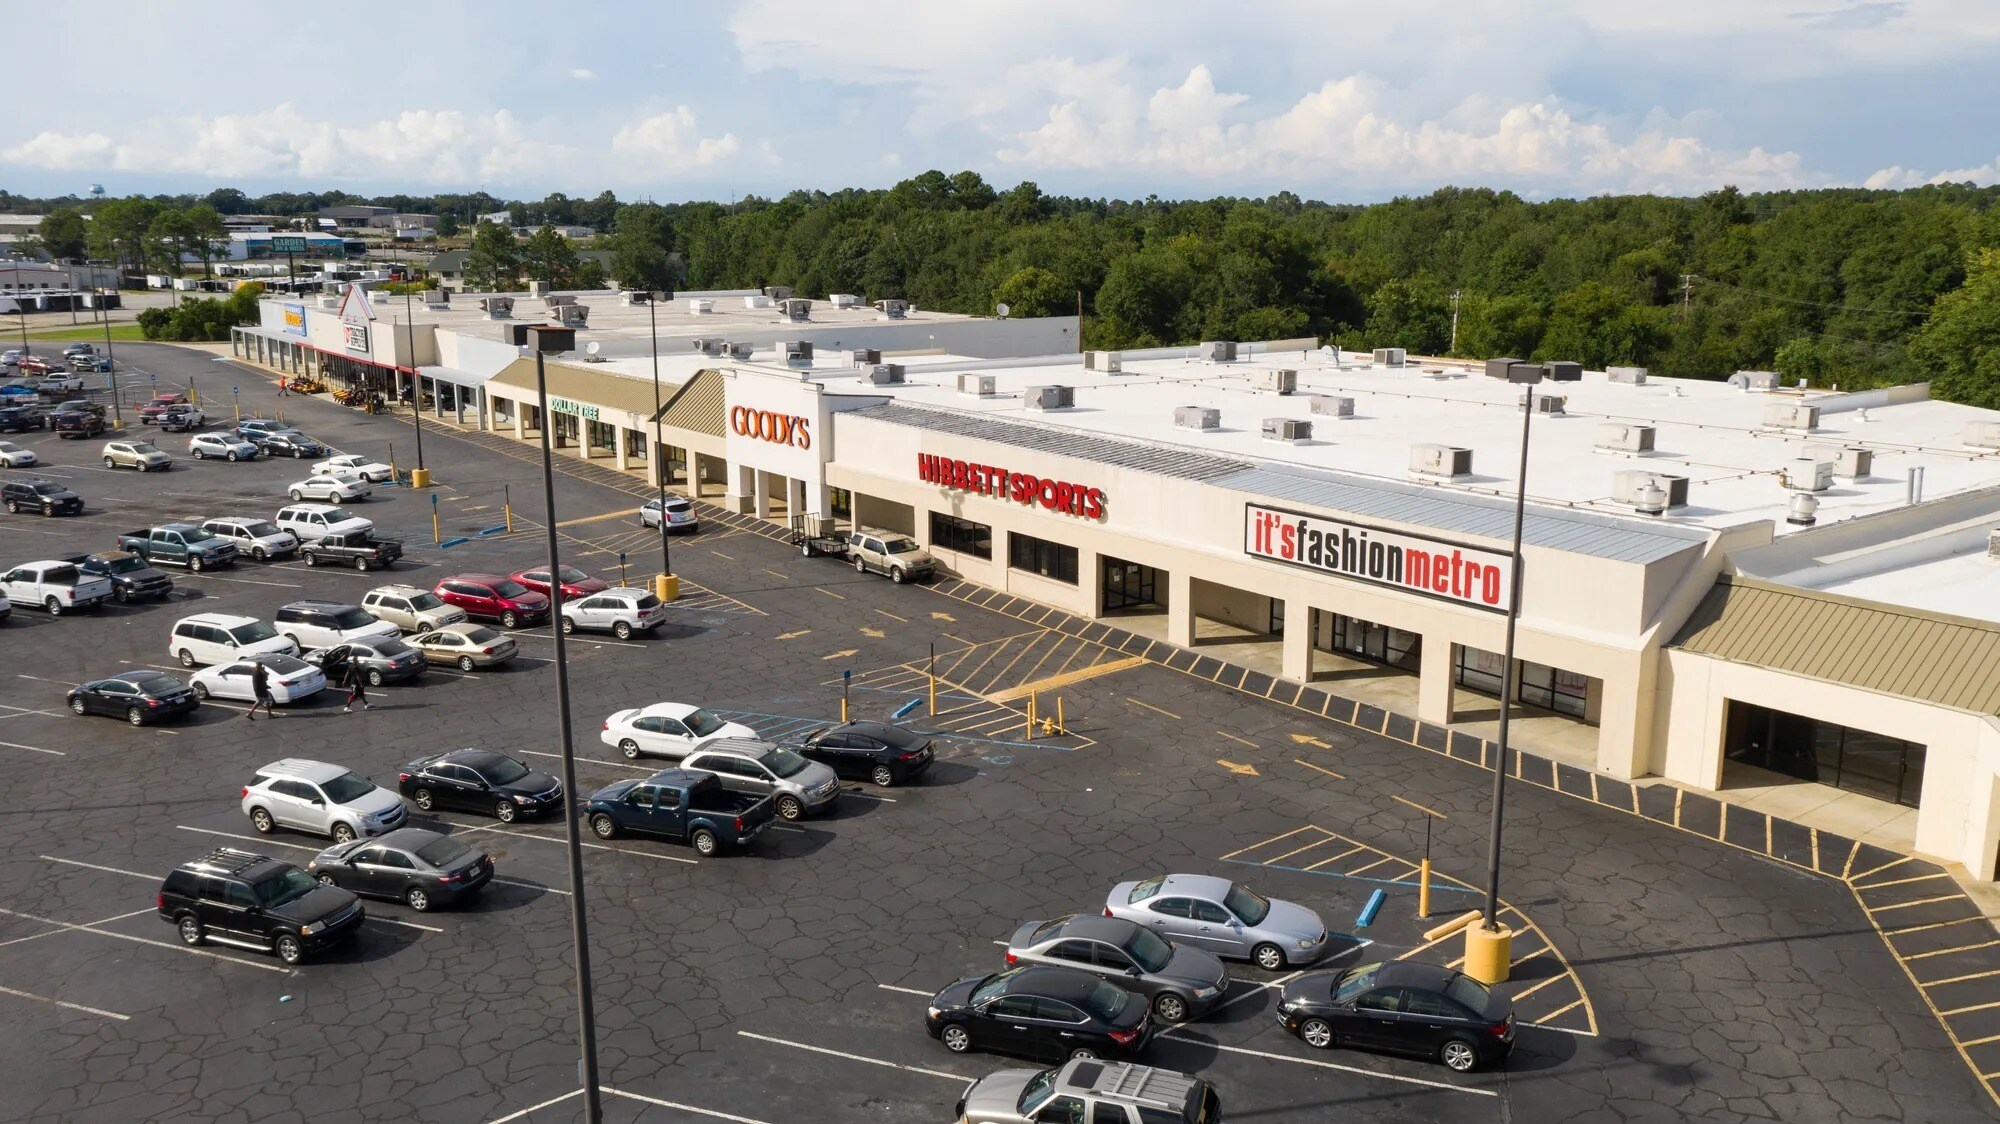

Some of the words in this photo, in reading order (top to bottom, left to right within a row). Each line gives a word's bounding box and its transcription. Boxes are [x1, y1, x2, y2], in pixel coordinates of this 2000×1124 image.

[273, 238, 305, 246] GARDEN
[551, 399, 579, 415] DOLLAR
[581, 405, 599, 420] TREE
[731, 405, 811, 450] GOODY'S
[918, 452, 1008, 498] HIBBETT
[1010, 472, 1104, 519] SPORTS
